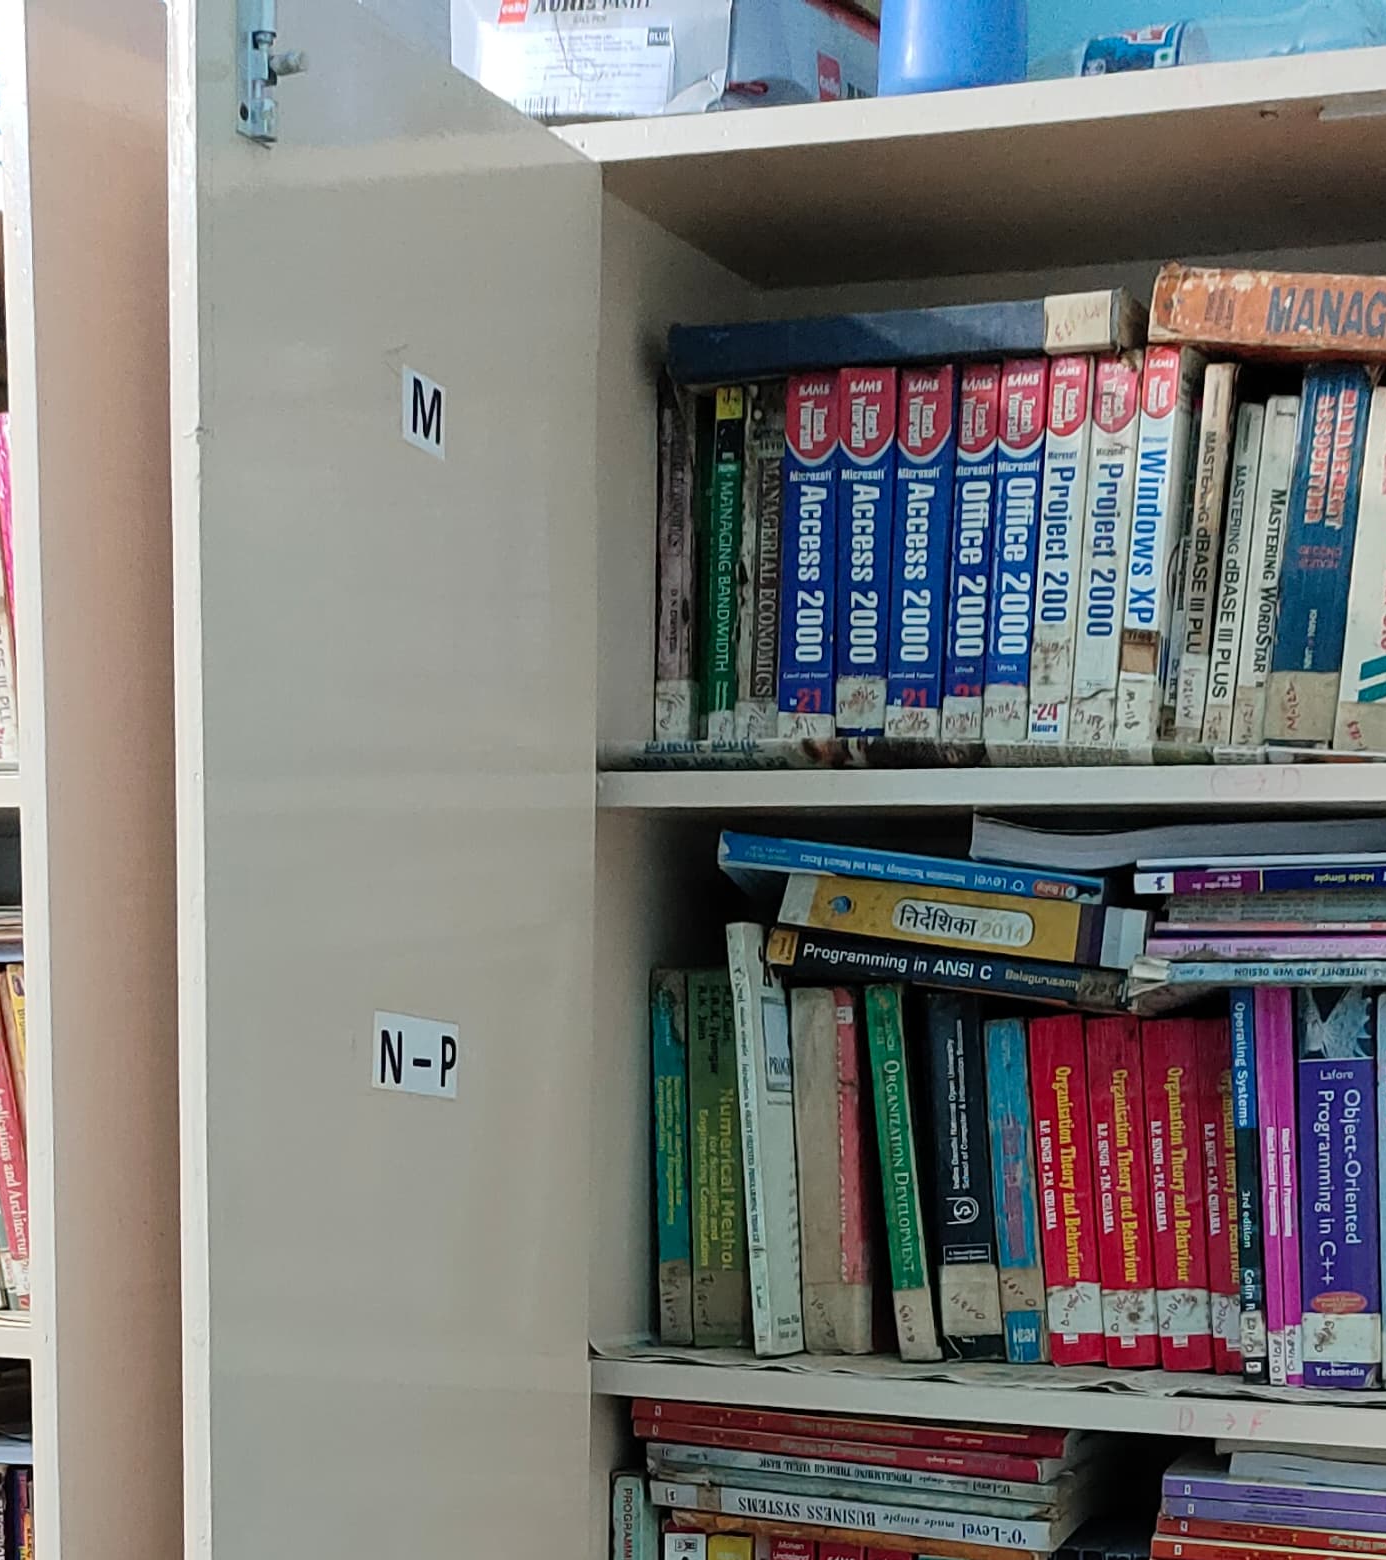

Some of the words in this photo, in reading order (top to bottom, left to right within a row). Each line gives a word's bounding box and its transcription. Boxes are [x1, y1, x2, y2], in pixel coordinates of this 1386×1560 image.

[412, 378, 442, 444] M
[797, 483, 823, 582] Access
[850, 483, 880, 583] Access
[960, 481, 991, 565] Office
[1003, 477, 1035, 562] Office
[1097, 462, 1125, 559] Project
[1131, 447, 1168, 584] Windows
[795, 591, 823, 663] 2000
[848, 591, 878, 664] 2000
[955, 575, 987, 658] 2000
[997, 572, 1029, 655] 2000
[1086, 567, 1115, 637] 2000
[1127, 590, 1156, 624] XP
[803, 944, 907, 974] Programming
[914, 958, 926, 973] in
[933, 960, 973, 979] ANSI
[979, 965, 992, 980] C
[1312, 1089, 1336, 1215] Programming
[1343, 1089, 1363, 1245] Object-Oriented
